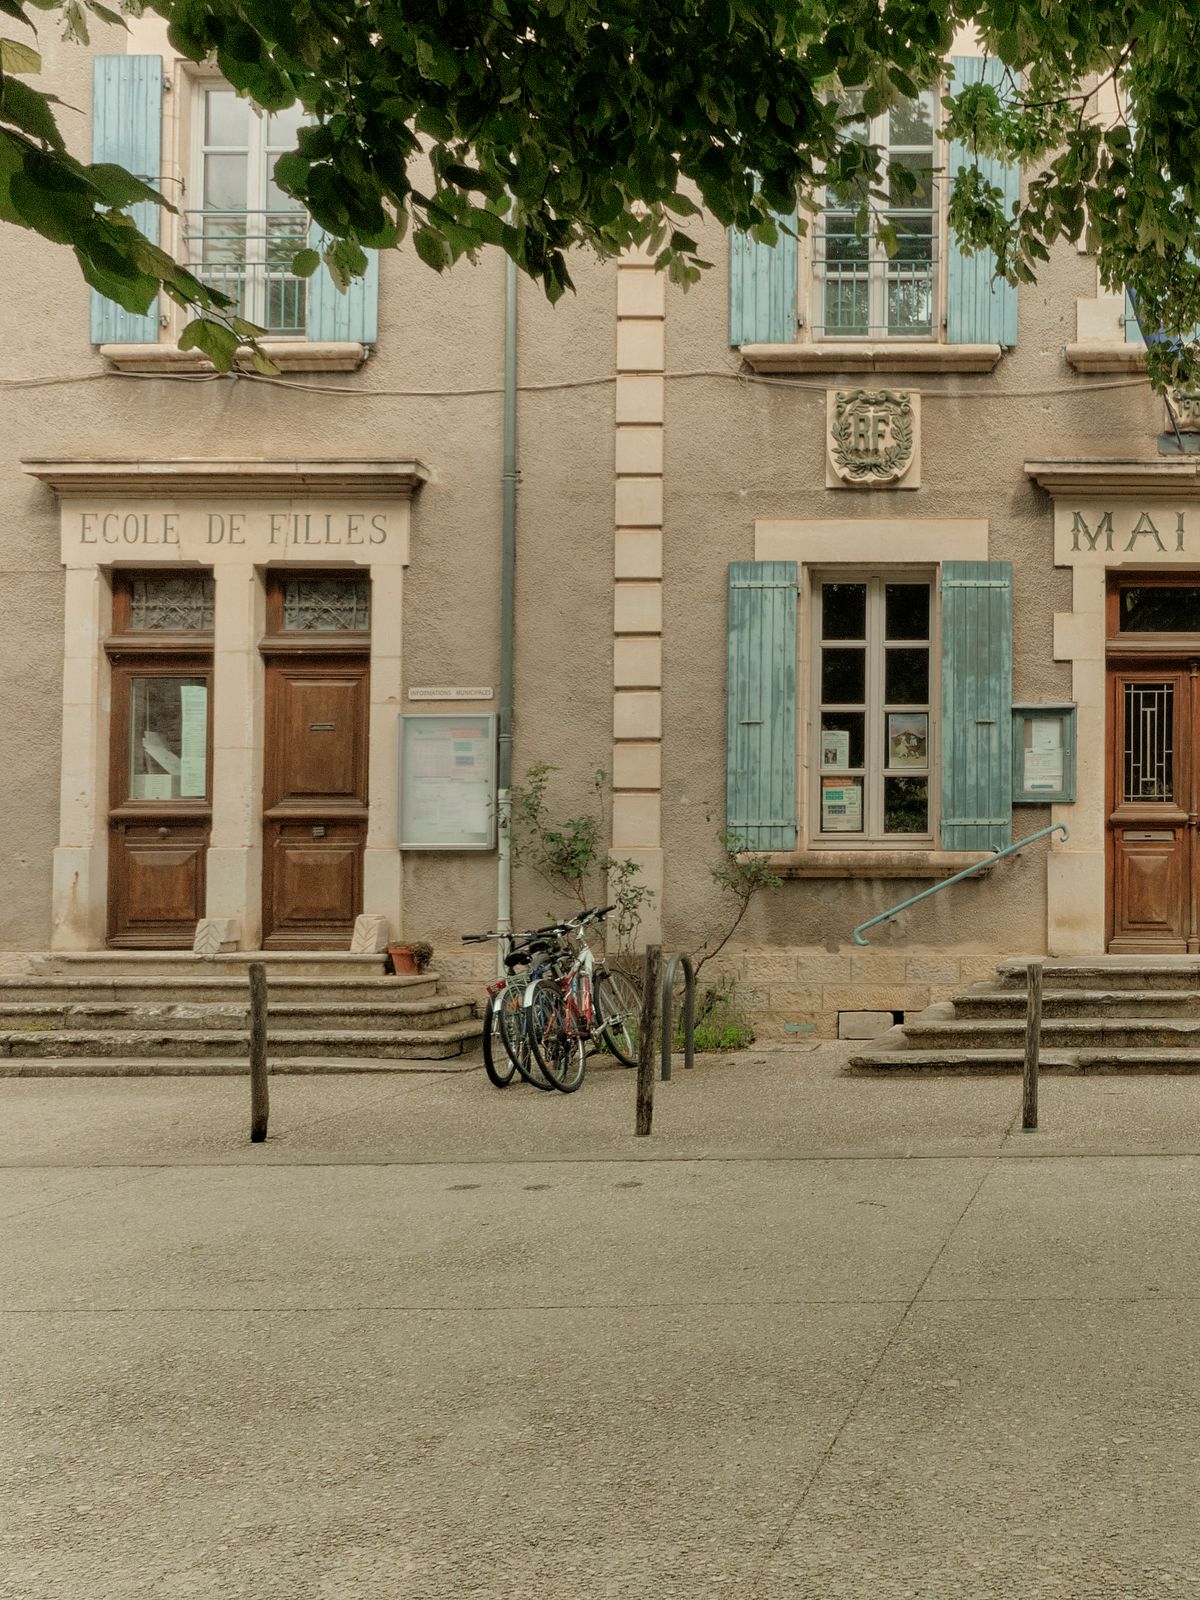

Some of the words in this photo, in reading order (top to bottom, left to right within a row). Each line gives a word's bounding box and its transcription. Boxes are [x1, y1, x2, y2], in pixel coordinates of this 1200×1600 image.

[853, 413, 889, 451] RF
[79, 513, 180, 545] ECOLE
[206, 513, 246, 545] DE
[268, 513, 388, 545] FILLES
